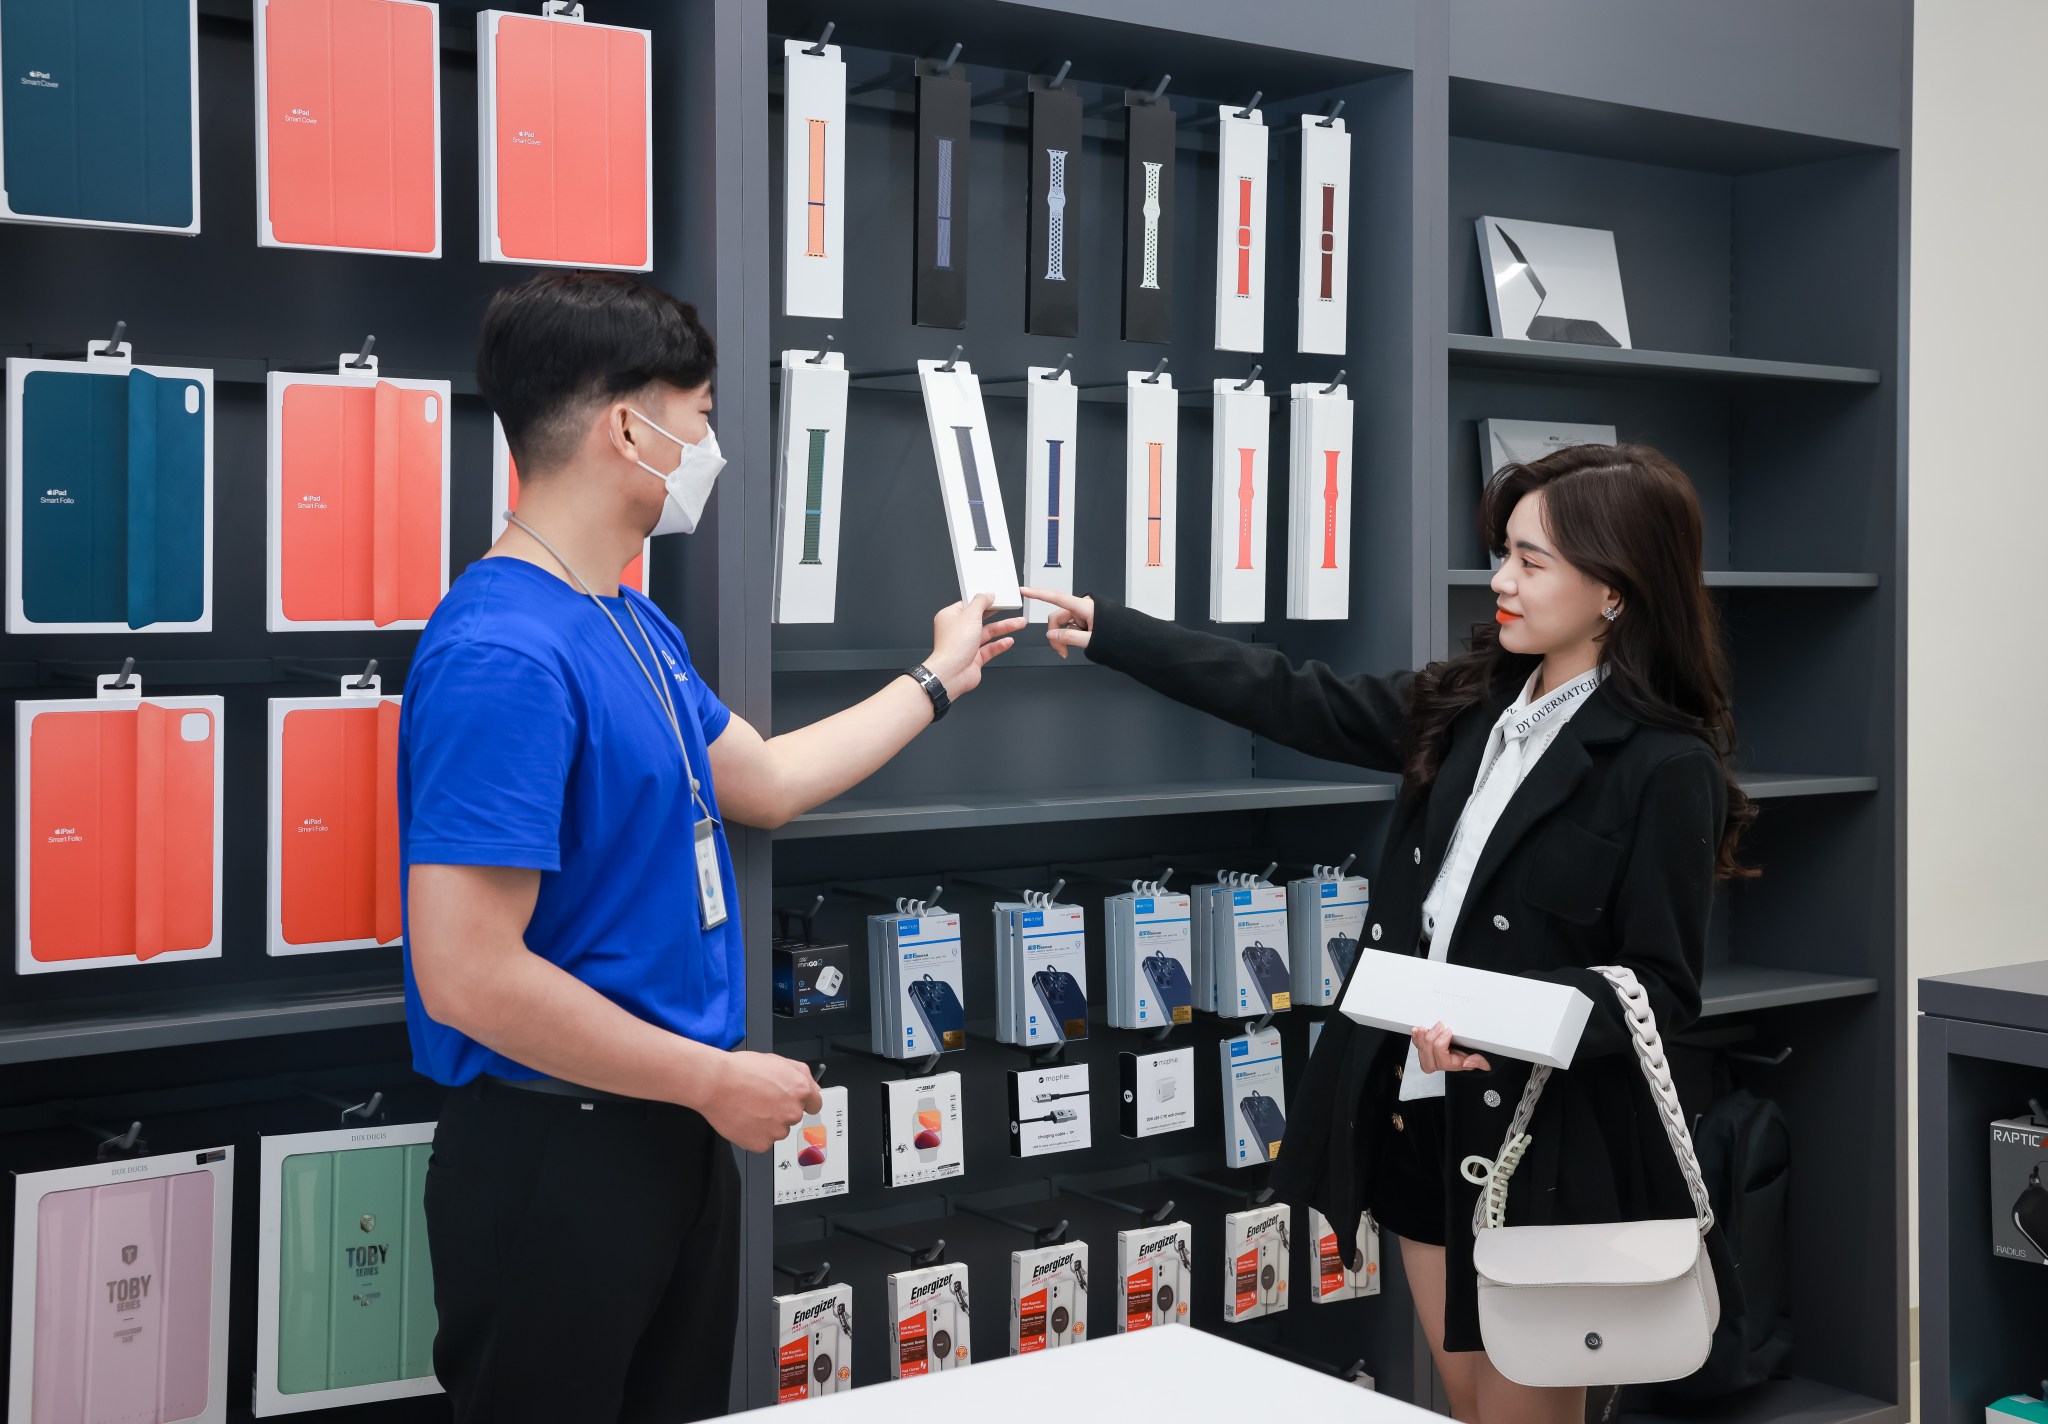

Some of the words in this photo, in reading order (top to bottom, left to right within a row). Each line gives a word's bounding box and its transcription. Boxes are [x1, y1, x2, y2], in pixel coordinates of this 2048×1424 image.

[34, 71, 51, 79] iPad
[21, 77, 41, 86] Smart
[40, 80, 59, 88] Cover
[284, 115, 301, 123] Smart
[40, 496, 60, 504] Smart
[60, 496, 75, 504] Folio
[1531, 678, 1598, 723] OVERMATCH
[1045, 1073, 1070, 1082] mophie
[351, 1134, 366, 1142] DUX
[366, 1133, 387, 1141] DUCIS
[1993, 1129, 2040, 1147] RAPTIC
[111, 1168, 125, 1176] DUX
[127, 1165, 148, 1174] DUCIS
[1246, 1214, 1279, 1239] Energizer
[1138, 1233, 1178, 1258] Energizer
[1996, 1245, 2026, 1257] RADIUS
[345, 1243, 389, 1269] TOBY
[355, 1266, 379, 1278] SERIES
[1032, 1253, 1074, 1279] Energizer
[106, 1274, 152, 1304] TOBY
[910, 1273, 954, 1301] Energizer
[116, 1299, 141, 1312] SERIES
[792, 1295, 838, 1326] Energizer
